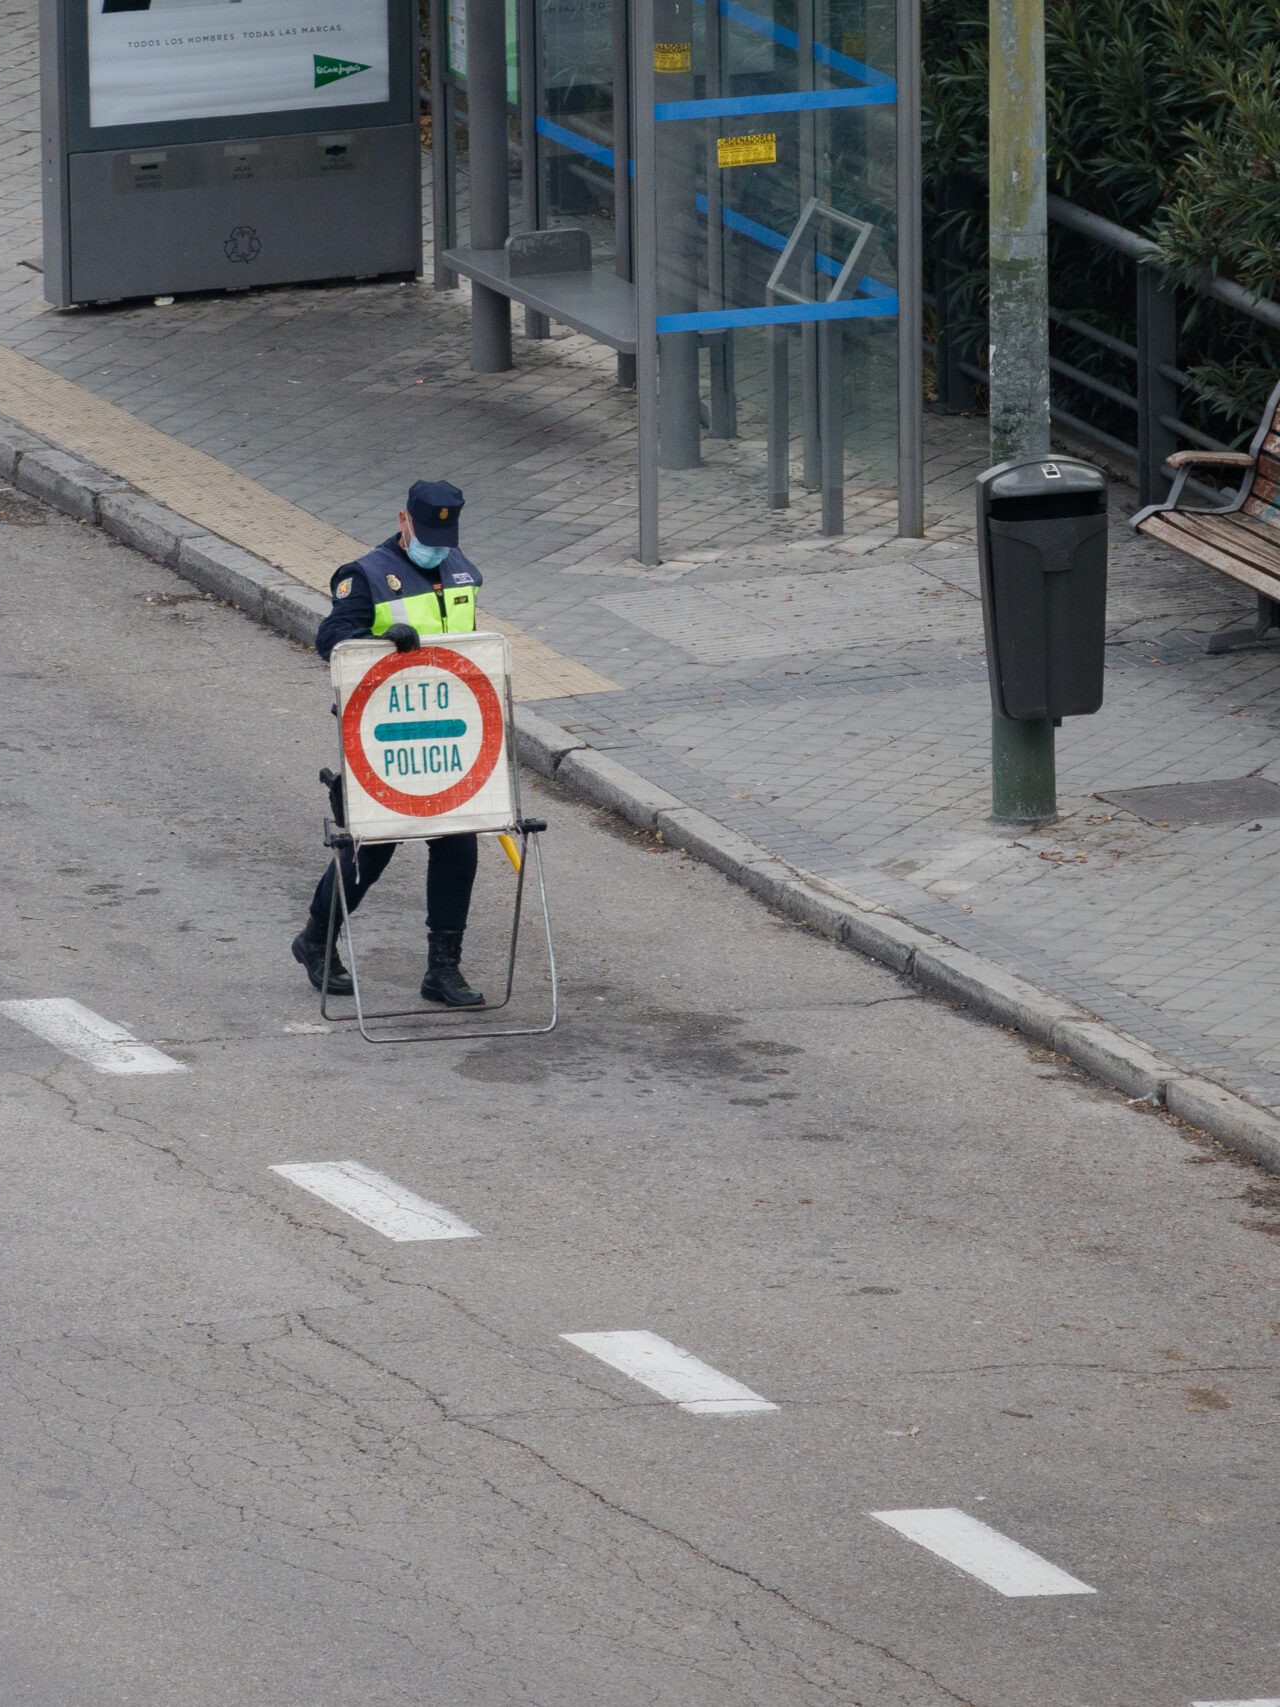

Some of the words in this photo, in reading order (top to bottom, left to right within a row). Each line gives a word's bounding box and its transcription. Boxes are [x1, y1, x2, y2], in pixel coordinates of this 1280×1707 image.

[127, 40, 161, 49] TODOS
[165, 38, 184, 47] LOS
[187, 34, 239, 44] HOMBRES.
[243, 31, 275, 40] TODAS
[279, 29, 298, 37] LAS
[302, 25, 345, 34] MARCAS.
[389, 682, 449, 713] ALTO
[384, 744, 463, 777] POLICIA
